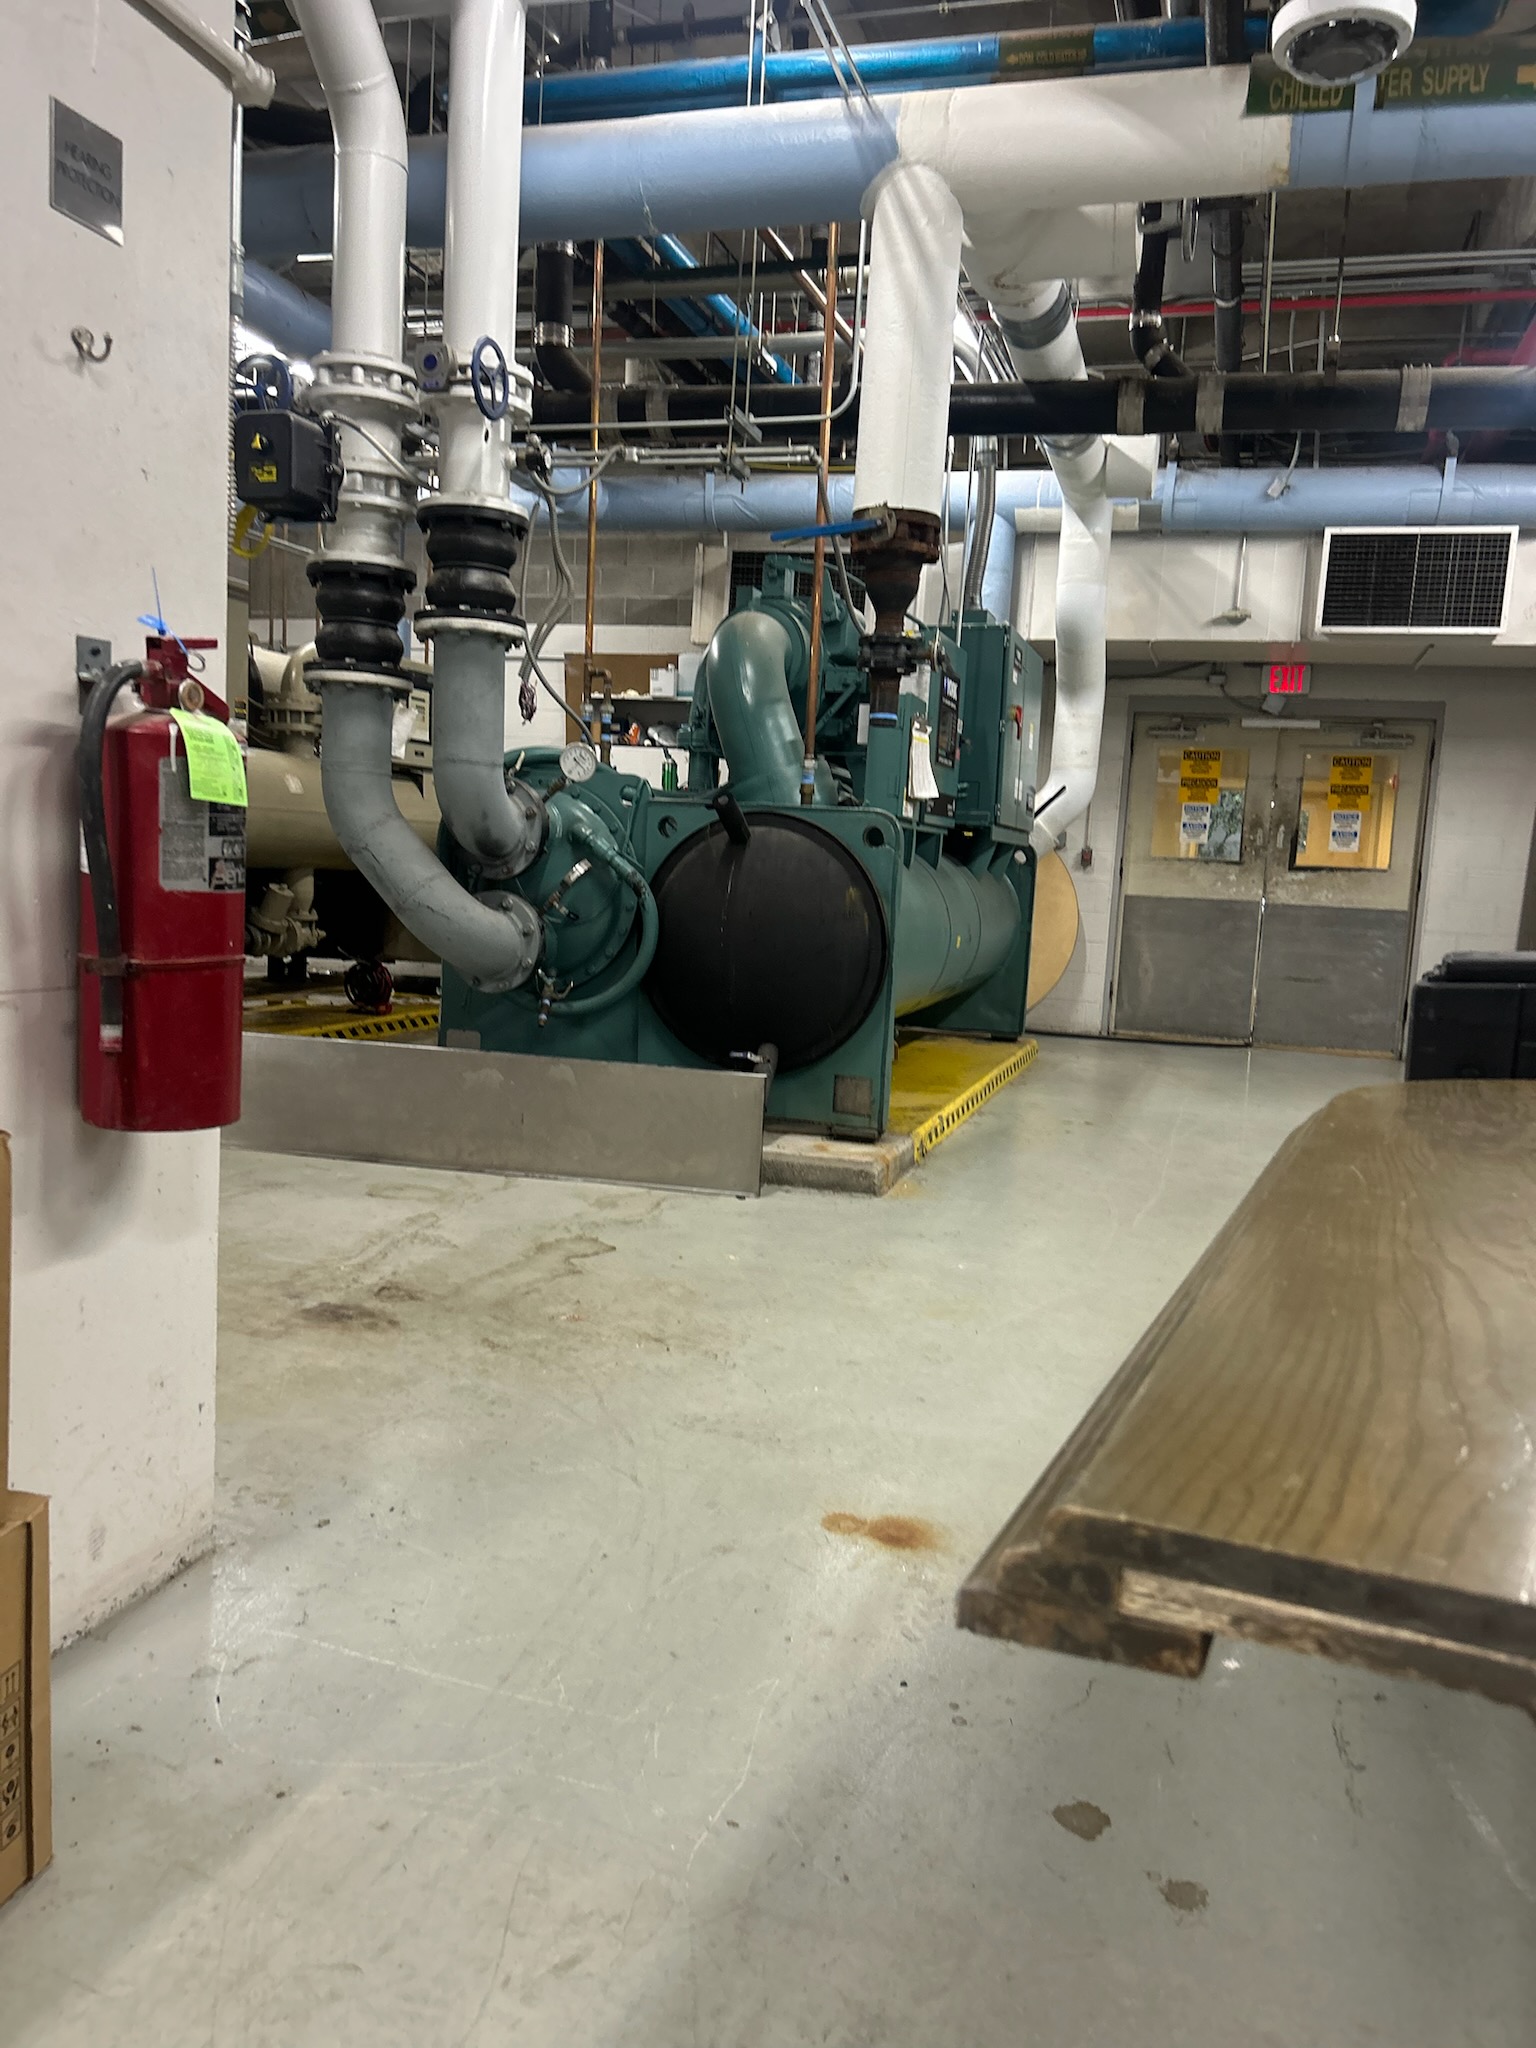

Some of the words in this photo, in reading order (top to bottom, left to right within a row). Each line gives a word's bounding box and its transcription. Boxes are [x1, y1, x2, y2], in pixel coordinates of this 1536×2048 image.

[1380, 67, 1413, 98] TER
[1422, 63, 1490, 95] SUPPLY
[64, 140, 112, 181] HEARING
[56, 159, 121, 209] PROTECTION
[1269, 664, 1306, 693] EXIT
[1184, 751, 1220, 760] CAUTION
[1333, 757, 1371, 767] CAUTION
